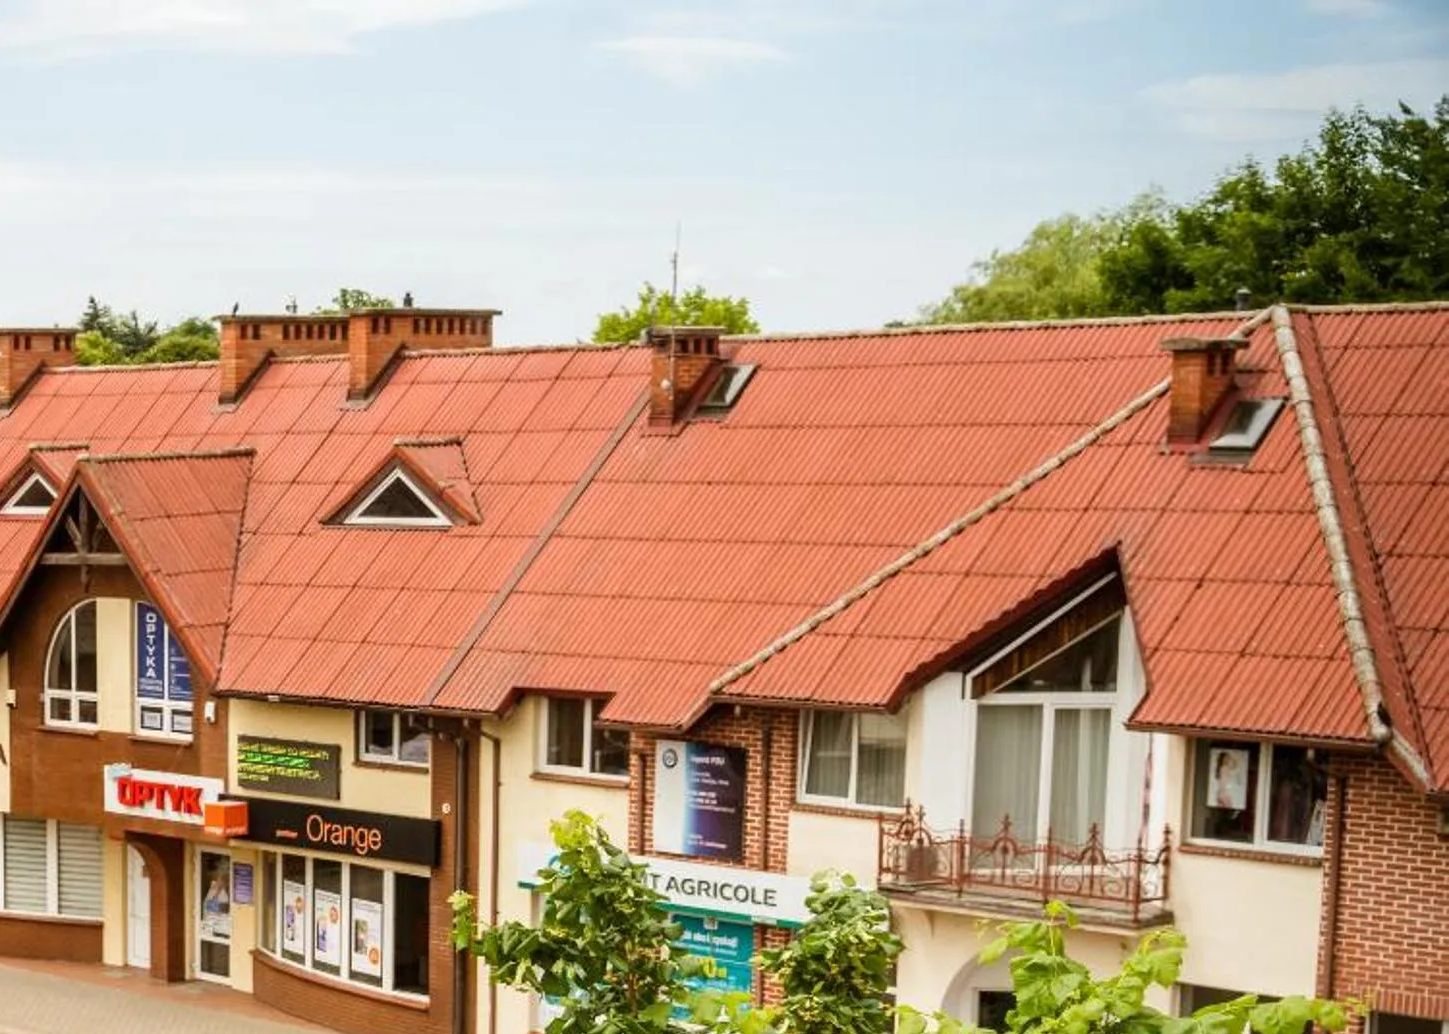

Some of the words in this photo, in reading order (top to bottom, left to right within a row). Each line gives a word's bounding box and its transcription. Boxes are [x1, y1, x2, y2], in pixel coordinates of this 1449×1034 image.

[145, 611, 158, 679] OPTYKA
[117, 775, 204, 816] OPTYK
[306, 814, 382, 855] Orange
[665, 876, 778, 907] AGRICOLE
